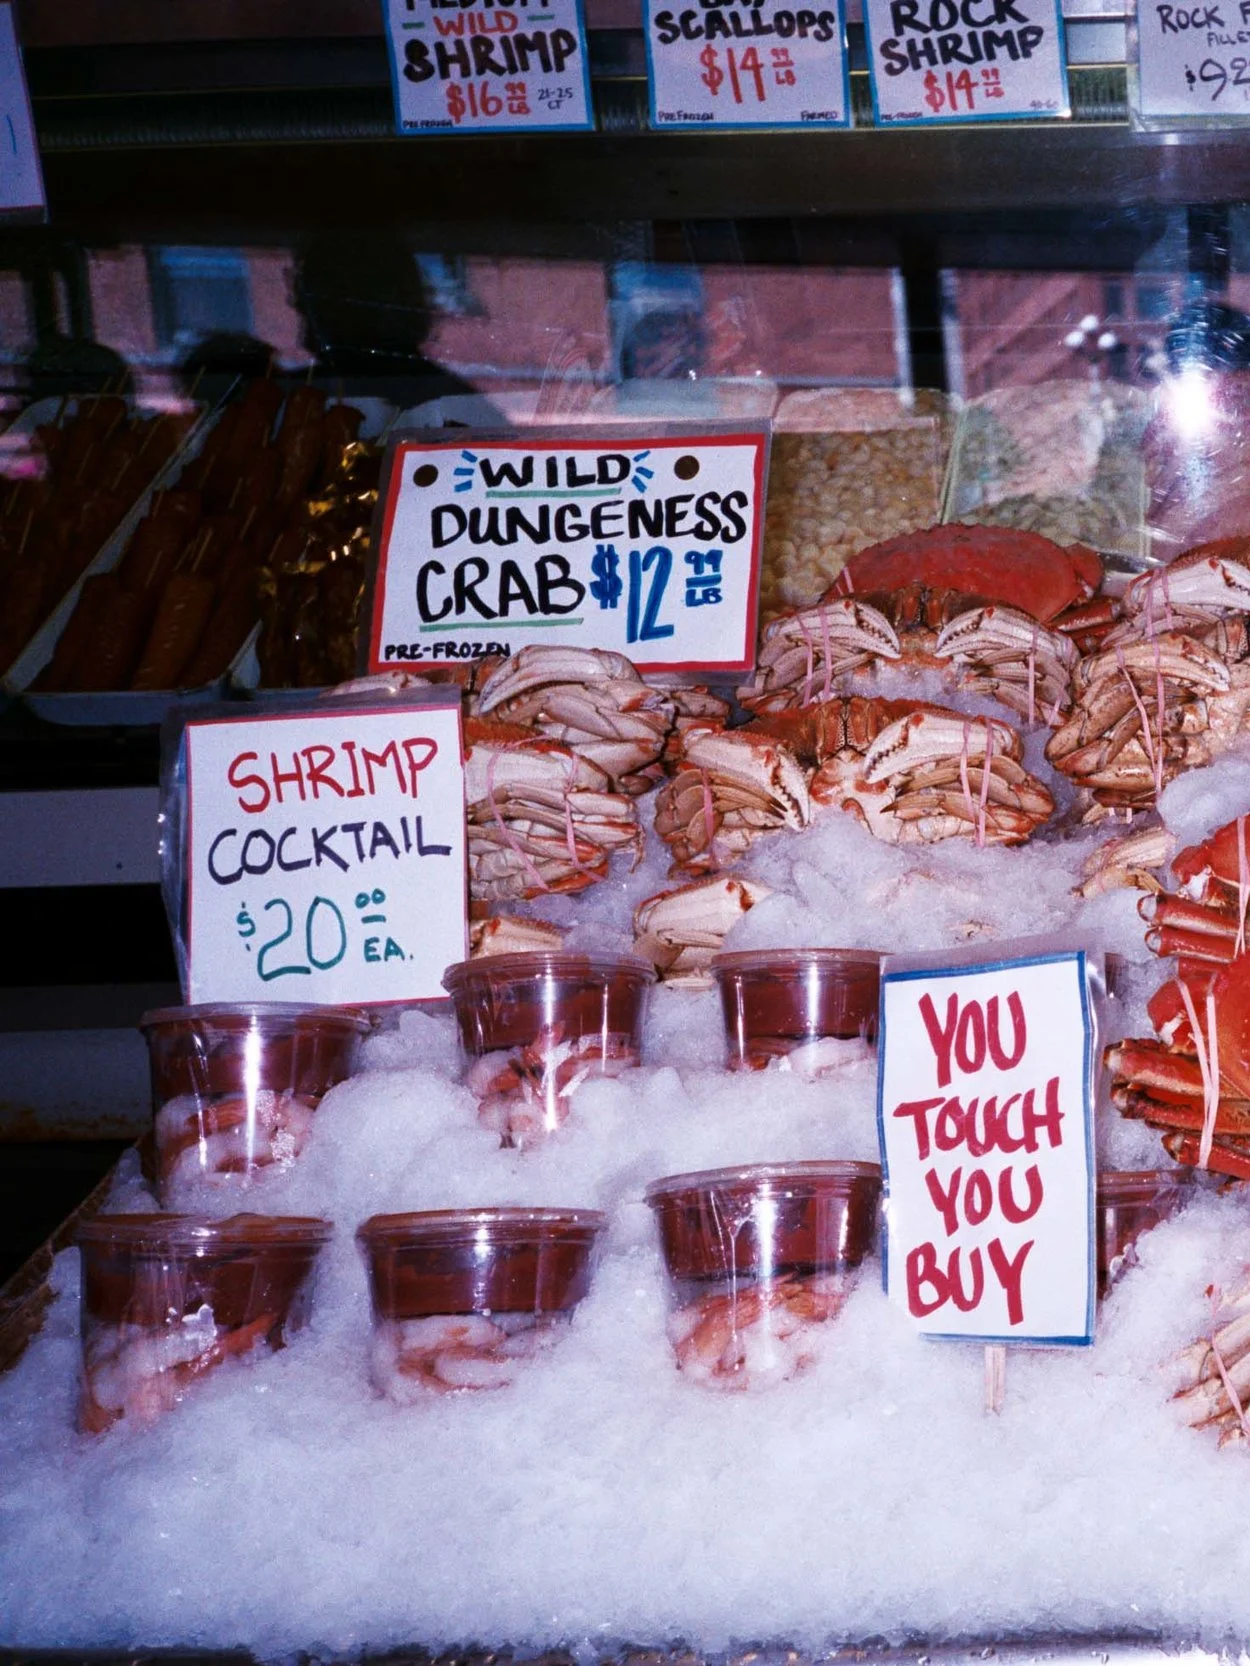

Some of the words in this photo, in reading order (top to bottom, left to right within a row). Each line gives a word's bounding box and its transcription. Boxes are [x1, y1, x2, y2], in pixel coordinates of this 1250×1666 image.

[433, 10, 518, 36] WILD
[654, 9, 835, 44] SCALLOPS
[890, 0, 1030, 37] ROCK
[1156, 4, 1225, 34] ROCK
[403, 28, 577, 82] SHRIMP
[880, 25, 1044, 76] SHRIMP
[479, 453, 631, 488] WILD
[430, 490, 749, 549] DUNGENESS
[415, 554, 586, 622] CRAB
[589, 544, 675, 643] $12
[685, 587, 722, 607] LB
[385, 641, 511, 660] PRE-FROZEN
[228, 737, 438, 813] SHRIMP
[208, 815, 452, 885] COCKTAIL
[364, 936, 414, 963] EA.
[918, 990, 1027, 1089] YOU
[893, 1076, 1064, 1161] TOUCH
[924, 1164, 1043, 1237] YOU
[906, 1237, 1034, 1326] BUY
